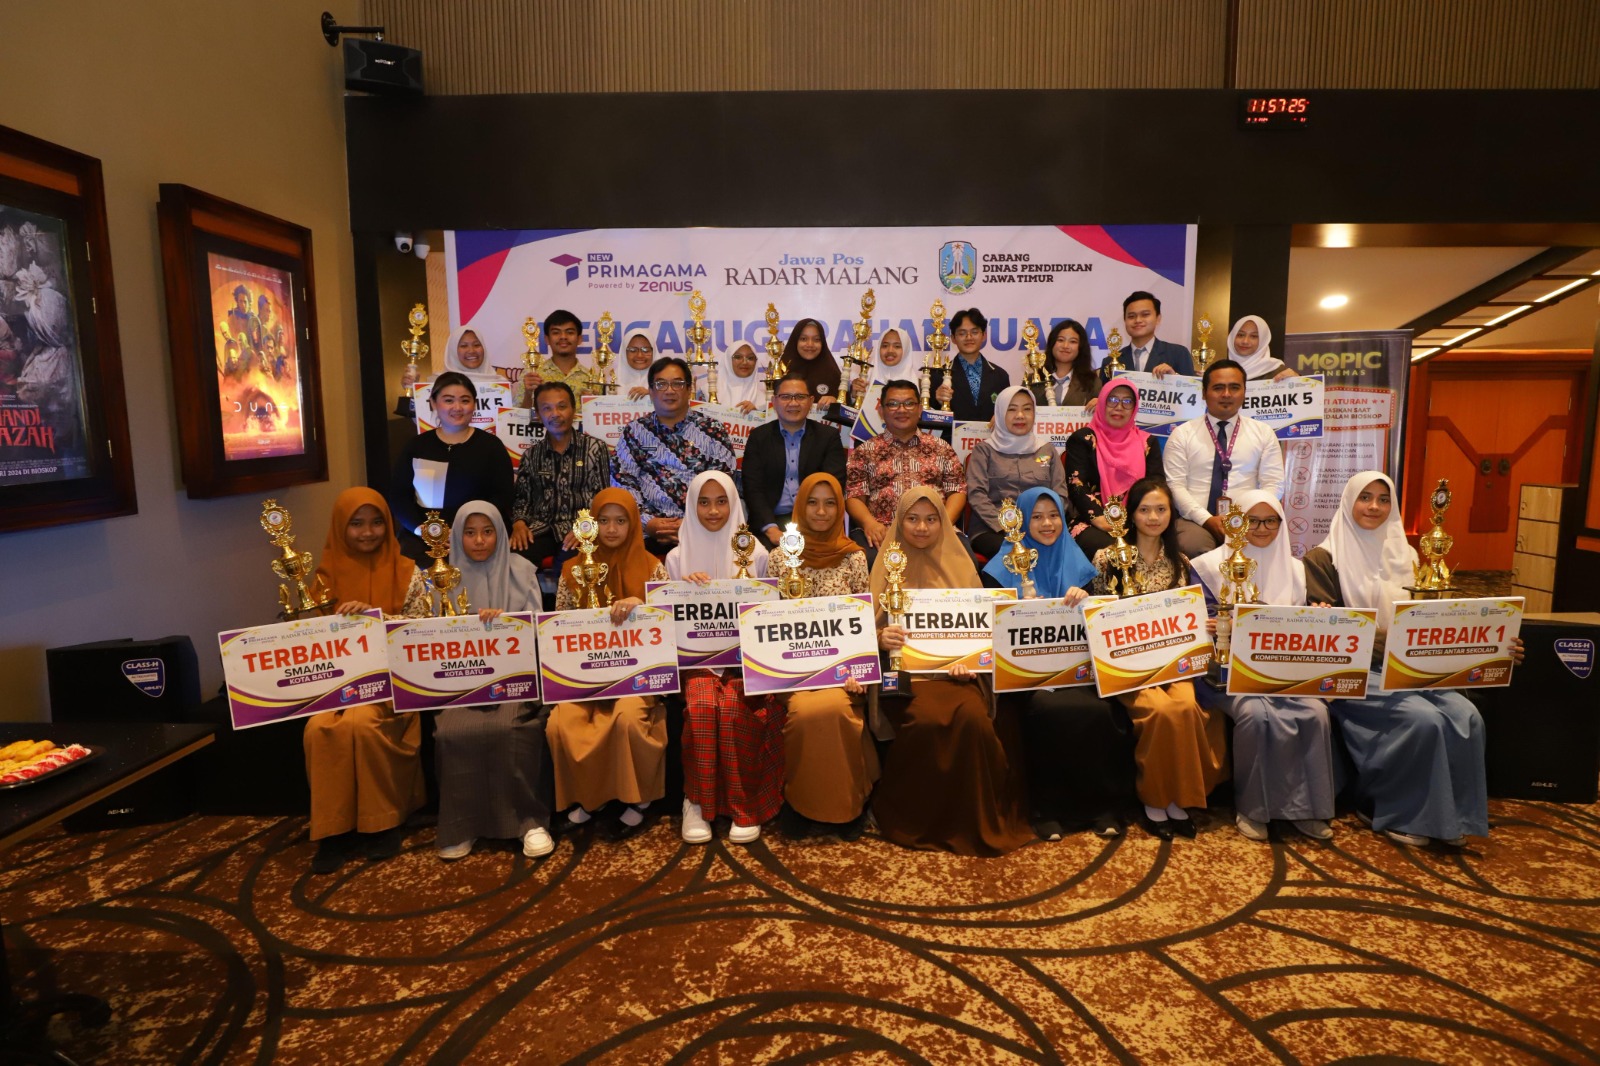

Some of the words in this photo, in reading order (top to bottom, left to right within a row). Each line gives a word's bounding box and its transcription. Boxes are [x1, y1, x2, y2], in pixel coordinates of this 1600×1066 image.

[778, 253, 826, 266] Jawa
[832, 253, 865, 266] Pos
[982, 254, 1030, 263] CABANG
[587, 264, 707, 278] PRIMAGAMA
[982, 264, 1018, 273] DINAS
[1020, 263, 1093, 273] PENDIDIKAN
[724, 266, 811, 286] RADAR
[815, 266, 919, 286] MALANG
[982, 274, 1015, 284] JAWA
[1015, 274, 1054, 283] TIMUR
[626, 282, 635, 290] by
[1297, 351, 1382, 371] MOPIC
[1186, 393, 1197, 406] 4
[1303, 392, 1313, 405] 5
[1141, 402, 1171, 410] SMA/MA
[1256, 407, 1288, 415] SMA/MA
[31, 467, 58, 475] BIOSKOP
[694, 622, 735, 630] SMA/MA
[903, 612, 989, 629] TERBAIK
[754, 618, 844, 643] TERBAIK
[849, 617, 862, 635] 5
[1008, 624, 1088, 646] TERBAIK
[1101, 615, 1182, 648] TERBAIK
[1184, 613, 1198, 631] 2
[1406, 625, 1491, 646] TERBAIK
[1495, 625, 1506, 642] 1
[552, 628, 644, 653] TERBAIK
[648, 627, 662, 645] 3
[788, 639, 831, 651] SMA/MA
[1113, 645, 1145, 657] KOMPETISI
[1146, 641, 1166, 650] ANTAR
[1166, 635, 1193, 646] SEKOLAH
[1249, 632, 1341, 653] TERBAIK
[1345, 635, 1359, 653] 3
[242, 638, 351, 673] TERBAIK
[356, 635, 369, 653] 1
[403, 638, 501, 662] TERBAIK
[505, 636, 521, 655] 2
[587, 649, 630, 661] SMA/MA
[1015, 648, 1048, 656] KOMPETISI
[1409, 649, 1443, 657] KOMPETISI
[126, 661, 159, 669] CLASS-H
[441, 659, 486, 670] SMA/MA
[1291, 655, 1316, 663] ANTAR
[284, 661, 335, 678] SMA/MA
[289, 675, 311, 685] KOTA
[311, 672, 333, 682] BATU
